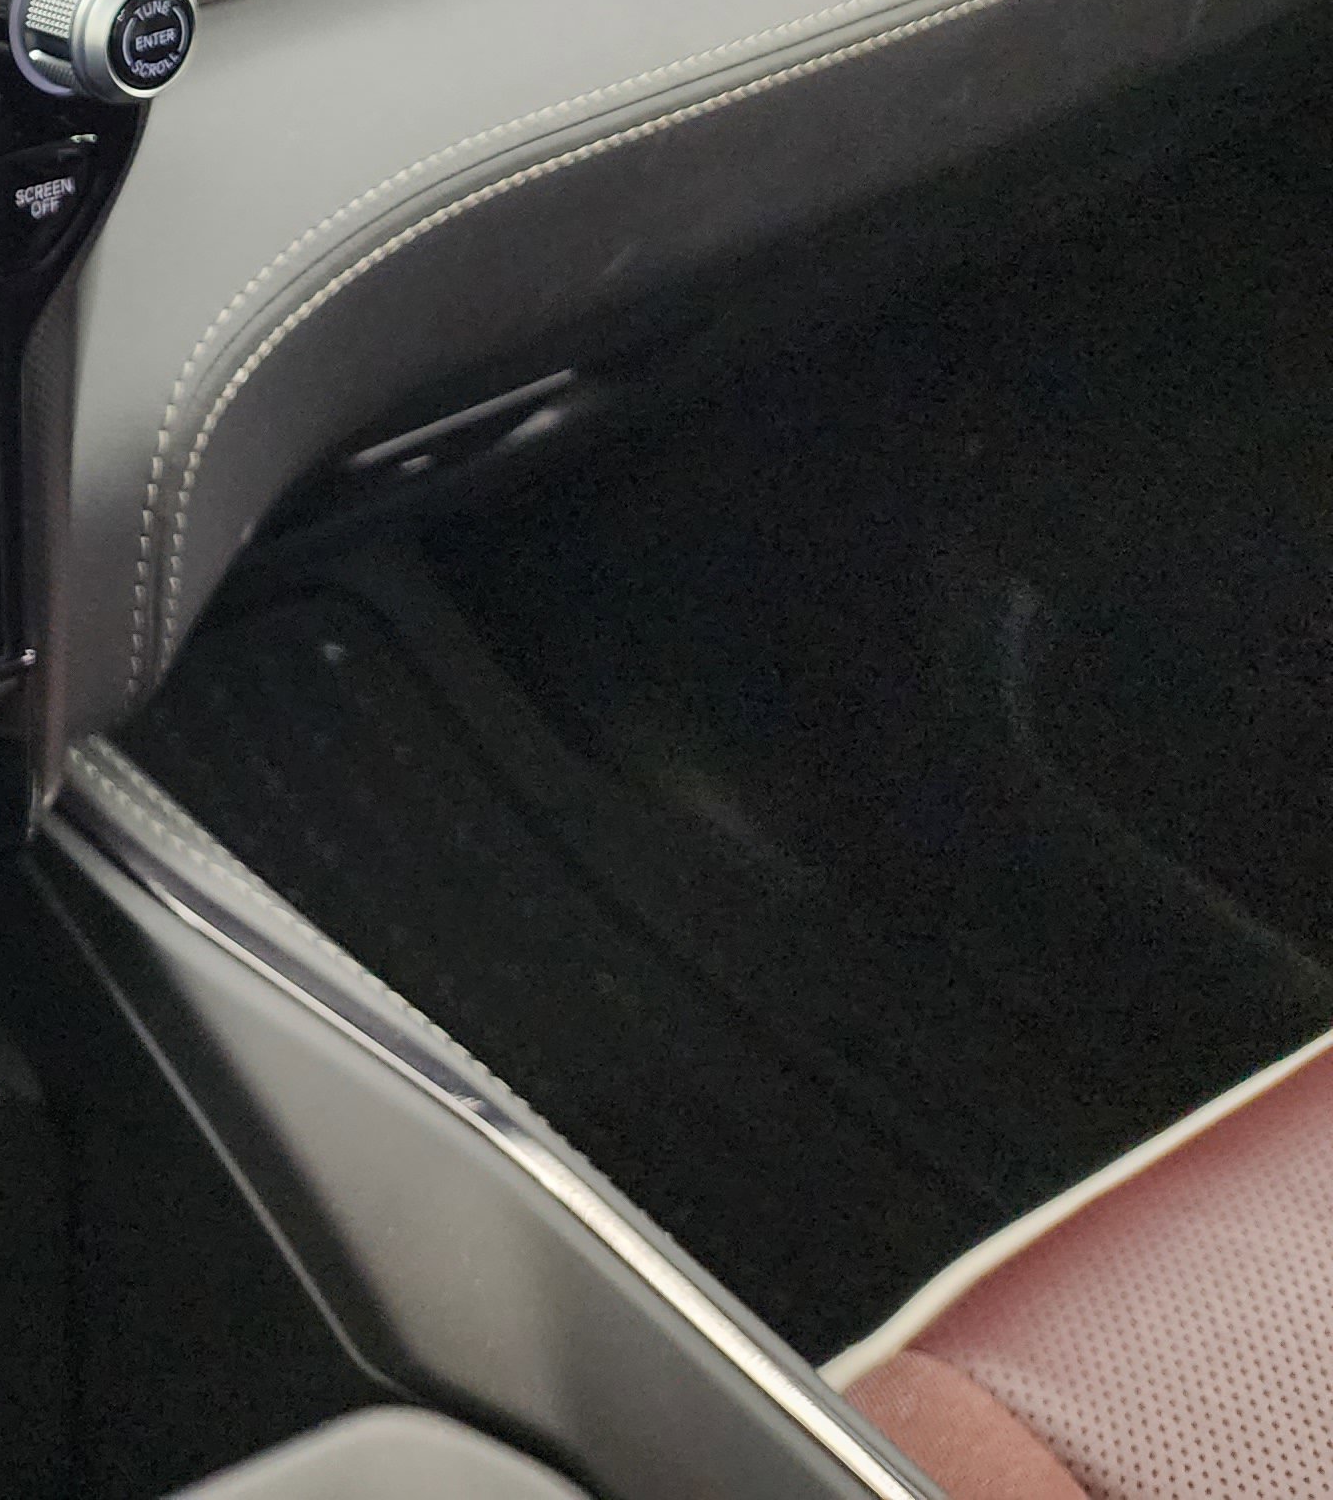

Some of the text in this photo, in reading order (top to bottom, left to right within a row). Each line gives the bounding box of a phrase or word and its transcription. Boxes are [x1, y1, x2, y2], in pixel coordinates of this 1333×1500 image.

[135, 1, 171, 22] TUNE
[135, 28, 176, 51] ENTER
[131, 52, 180, 79] SCROLL
[16, 177, 75, 208] SCREEN
[31, 195, 60, 219] OFF
